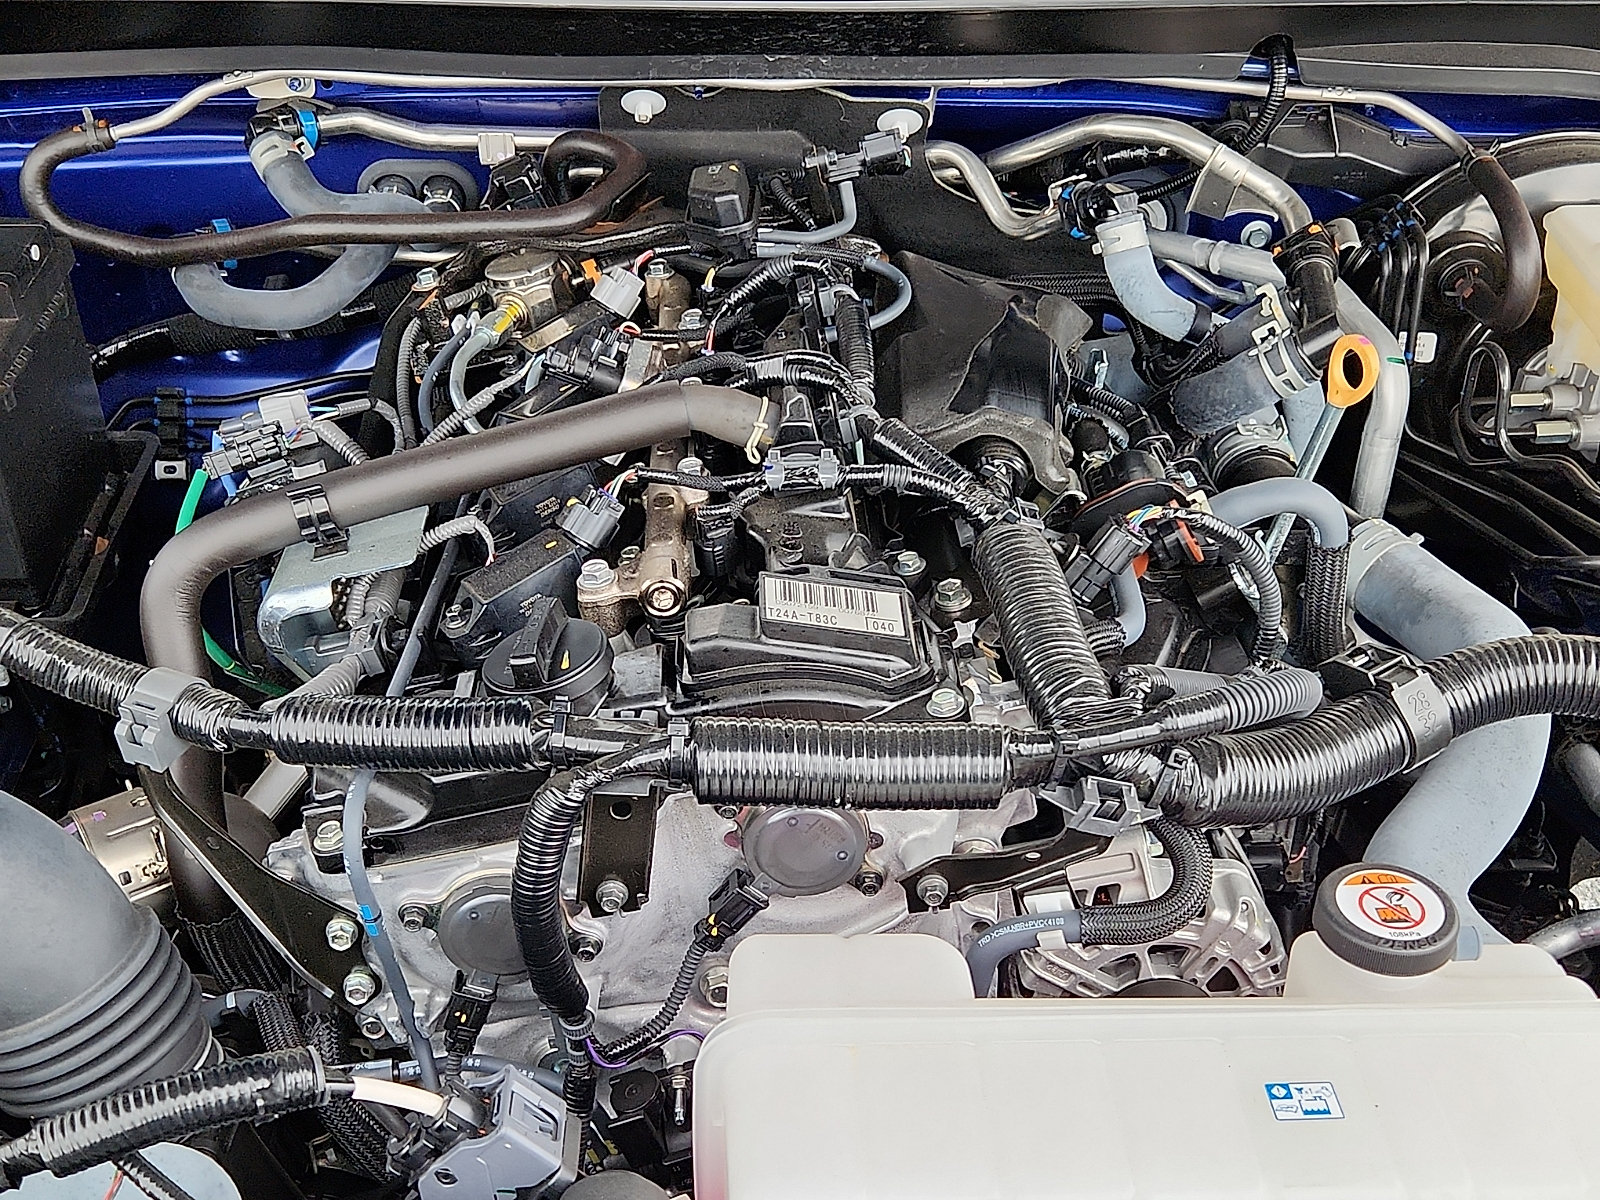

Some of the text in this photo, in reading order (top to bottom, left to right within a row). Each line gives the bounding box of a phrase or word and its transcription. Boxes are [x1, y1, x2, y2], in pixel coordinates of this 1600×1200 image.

[519, 593, 543, 608] TOYOTA
[767, 607, 838, 626] T24A-T83C
[872, 620, 895, 633] 040
[1407, 689, 1431, 717] 28
[1418, 710, 1442, 738] 32
[1377, 935, 1439, 950] DENSO
